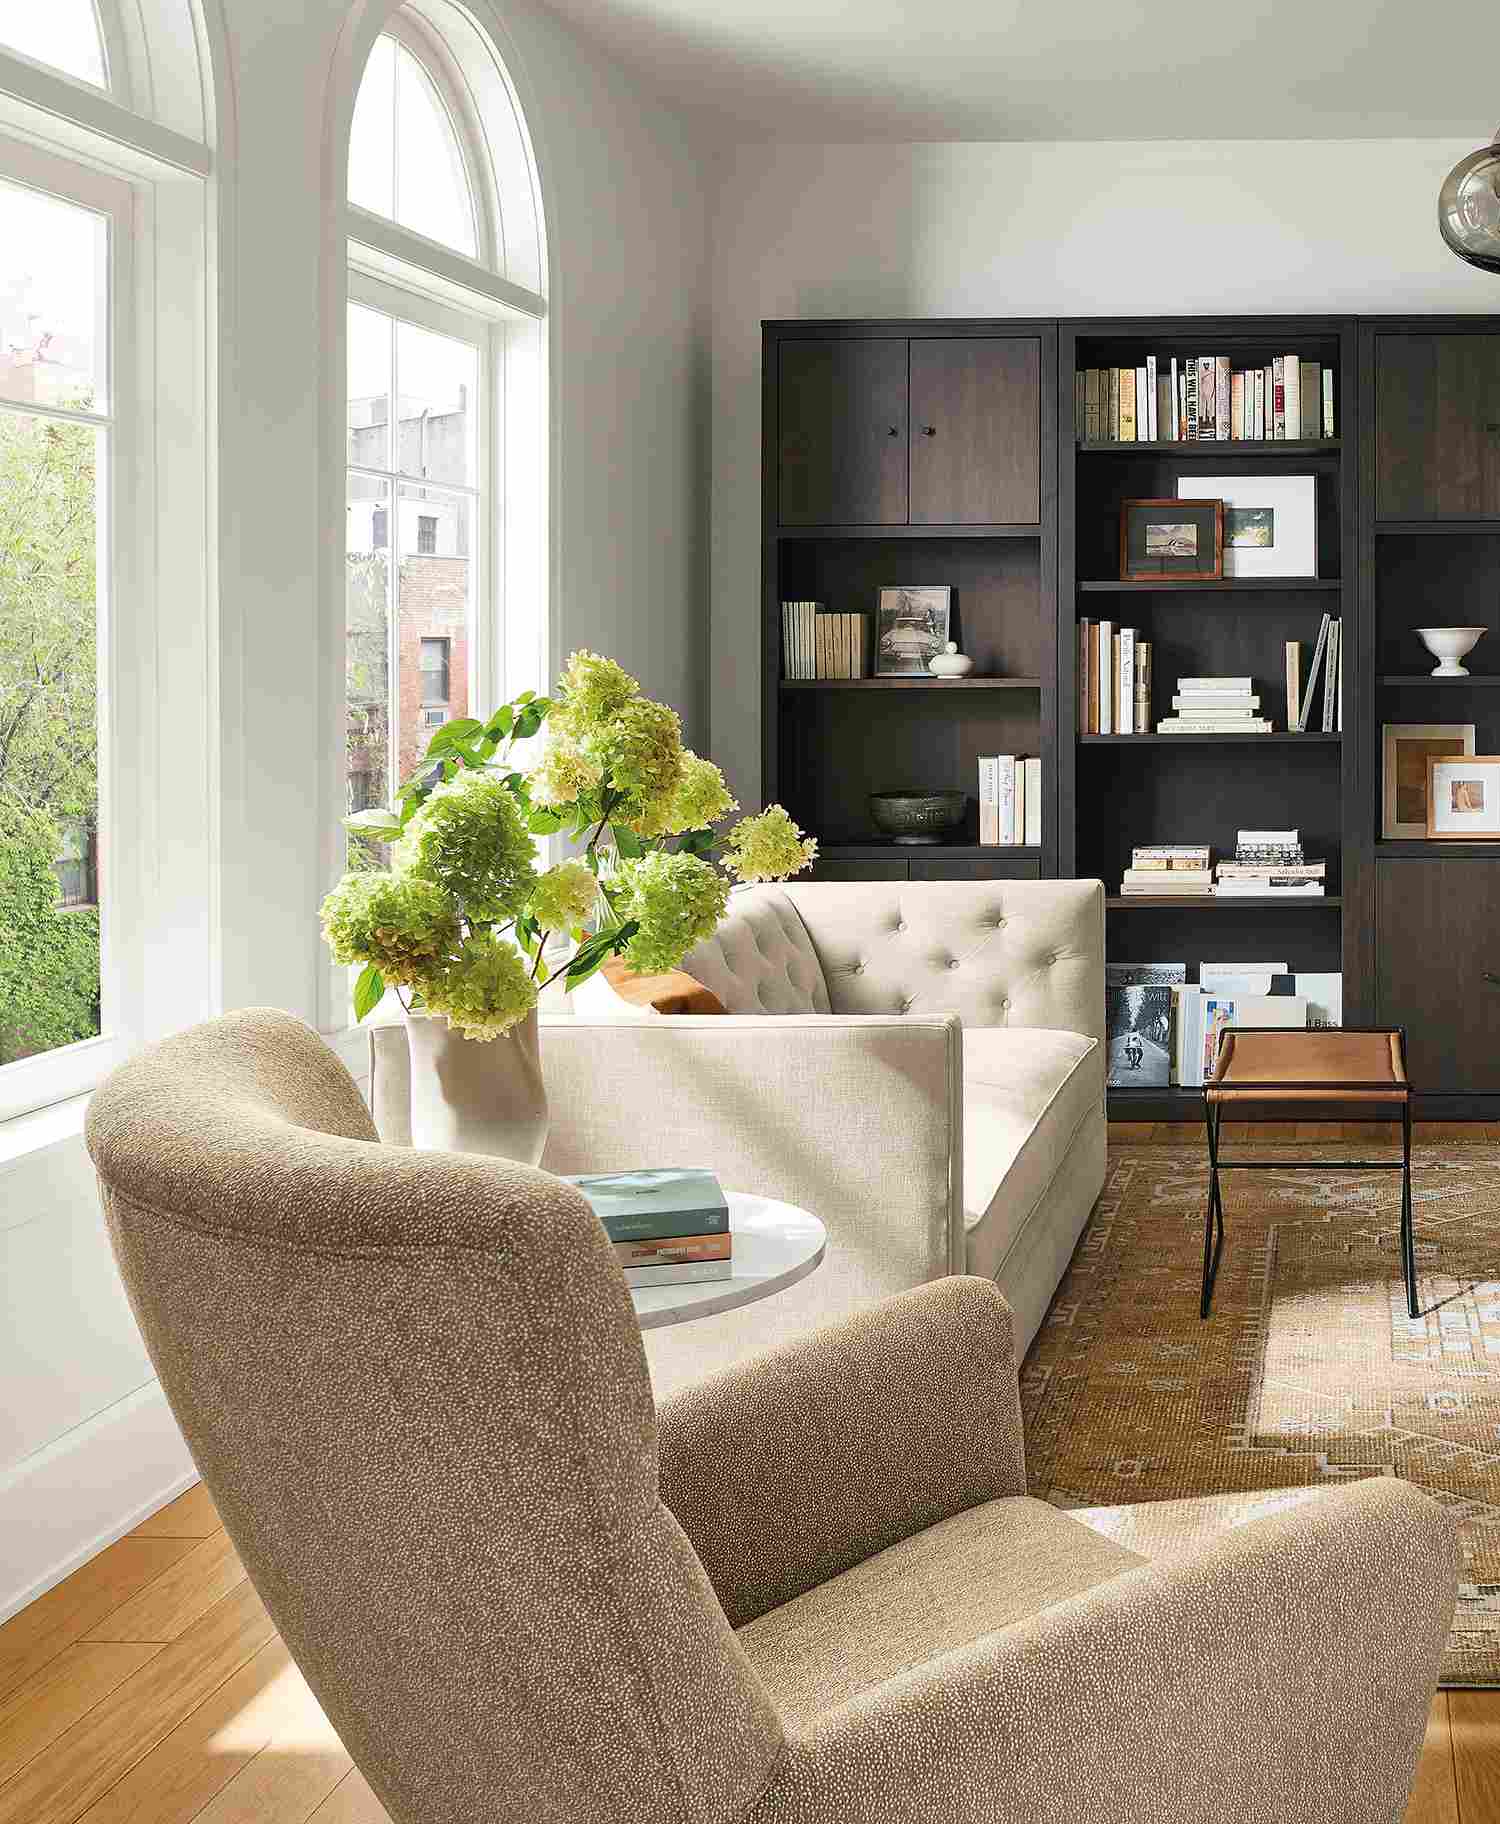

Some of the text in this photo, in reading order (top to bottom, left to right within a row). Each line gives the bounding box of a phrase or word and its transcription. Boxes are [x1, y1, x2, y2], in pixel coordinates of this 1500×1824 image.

[1187, 360, 1197, 377] THIS
[1187, 379, 1197, 398] WILL
[1187, 400, 1197, 423] HAVE
